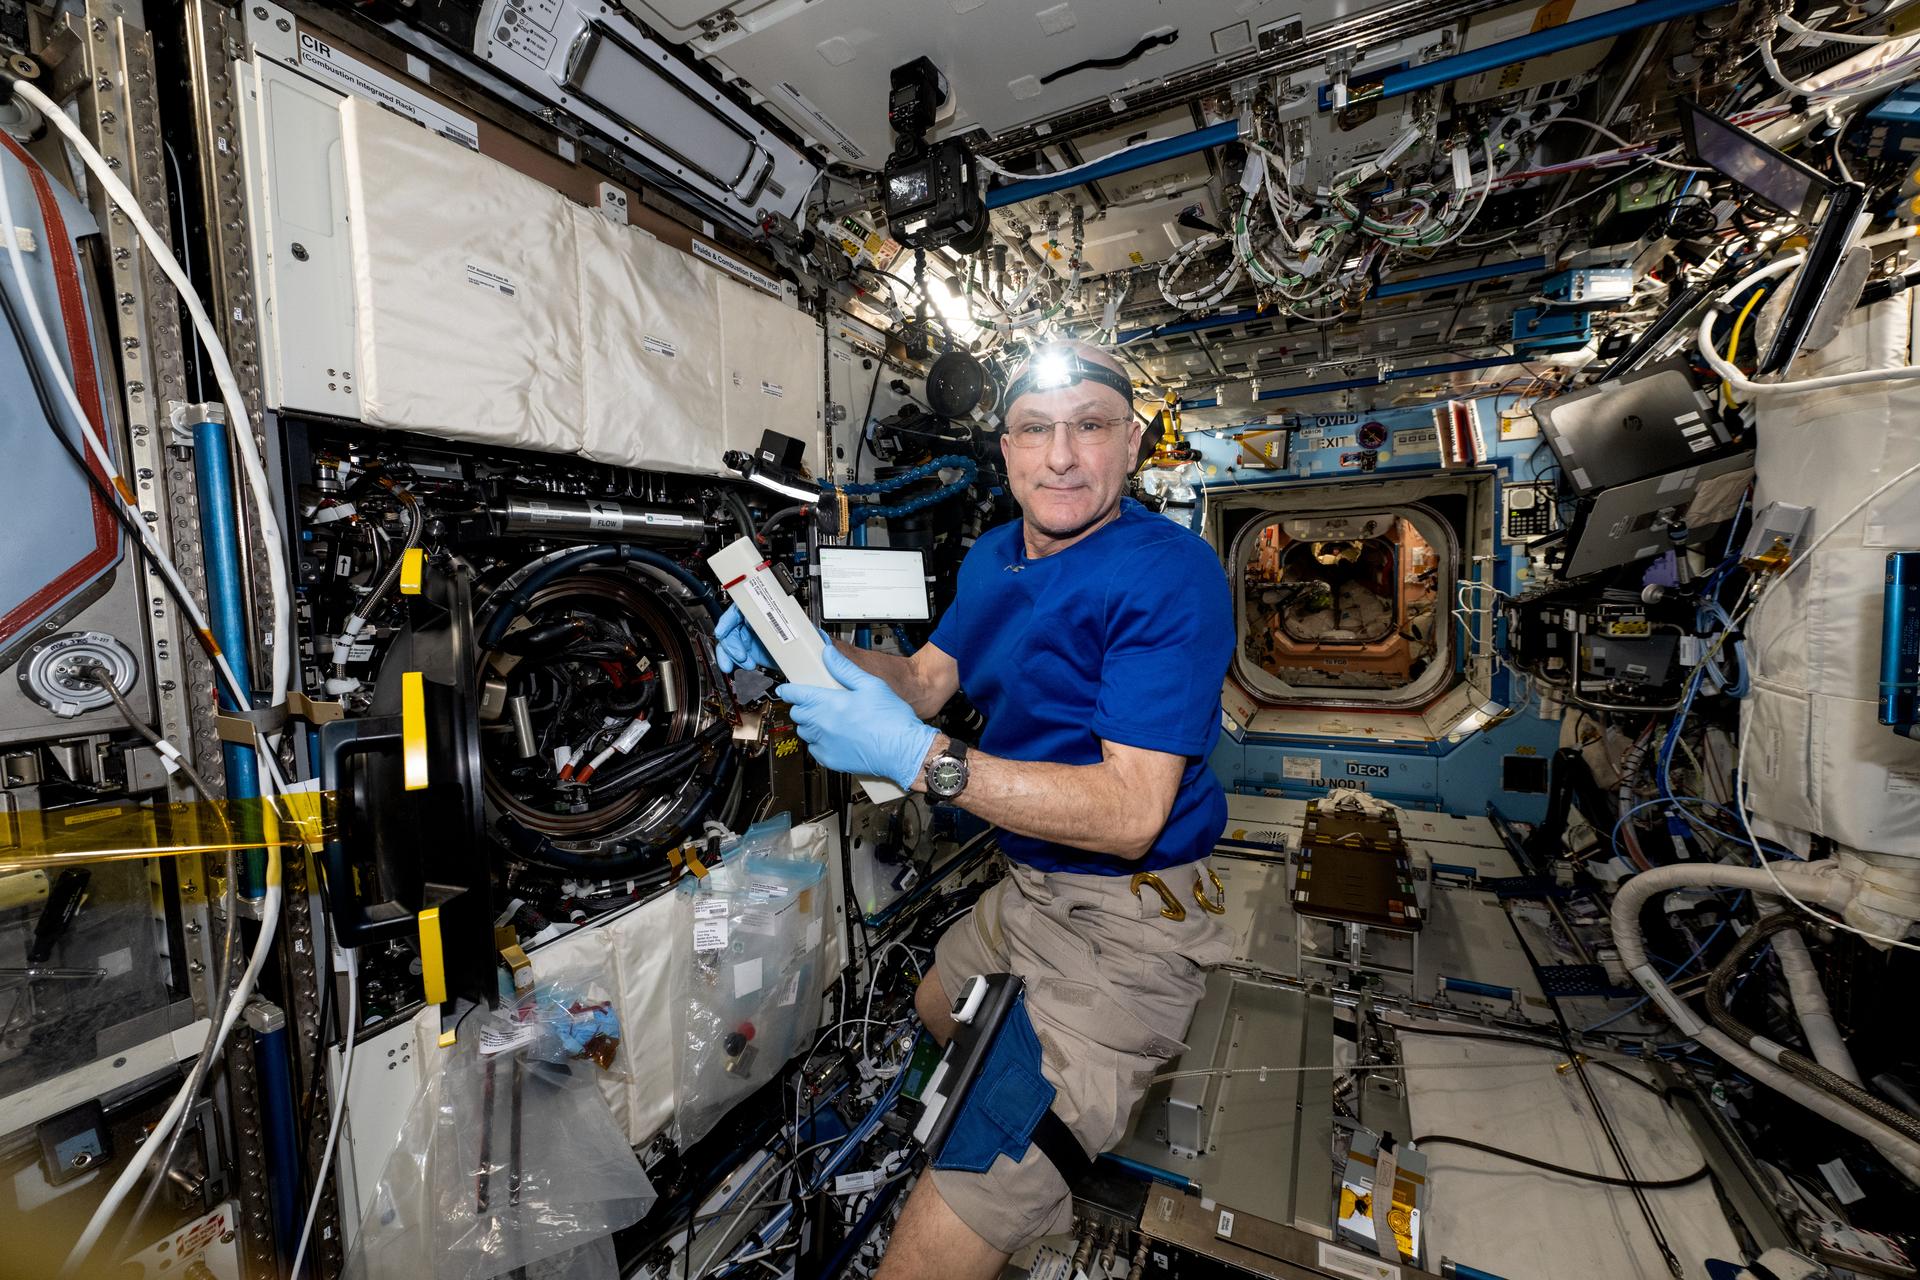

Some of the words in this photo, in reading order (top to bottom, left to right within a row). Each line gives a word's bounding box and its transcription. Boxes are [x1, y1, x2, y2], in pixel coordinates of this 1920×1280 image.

[301, 35, 331, 58] CIR
[302, 52, 355, 83] (Combustion
[356, 78, 394, 103] Integrated
[395, 99, 416, 115] Rack)
[693, 243, 711, 257] Fluids
[718, 256, 749, 276] Combustion
[749, 272, 767, 286] Facility
[767, 282, 780, 293] (FCF)
[1317, 414, 1357, 427] OVHD
[1349, 764, 1387, 777] DECK
[1310, 778, 1325, 787] TO
[1329, 778, 1356, 789] NOD
[1361, 781, 1365, 790] 1
